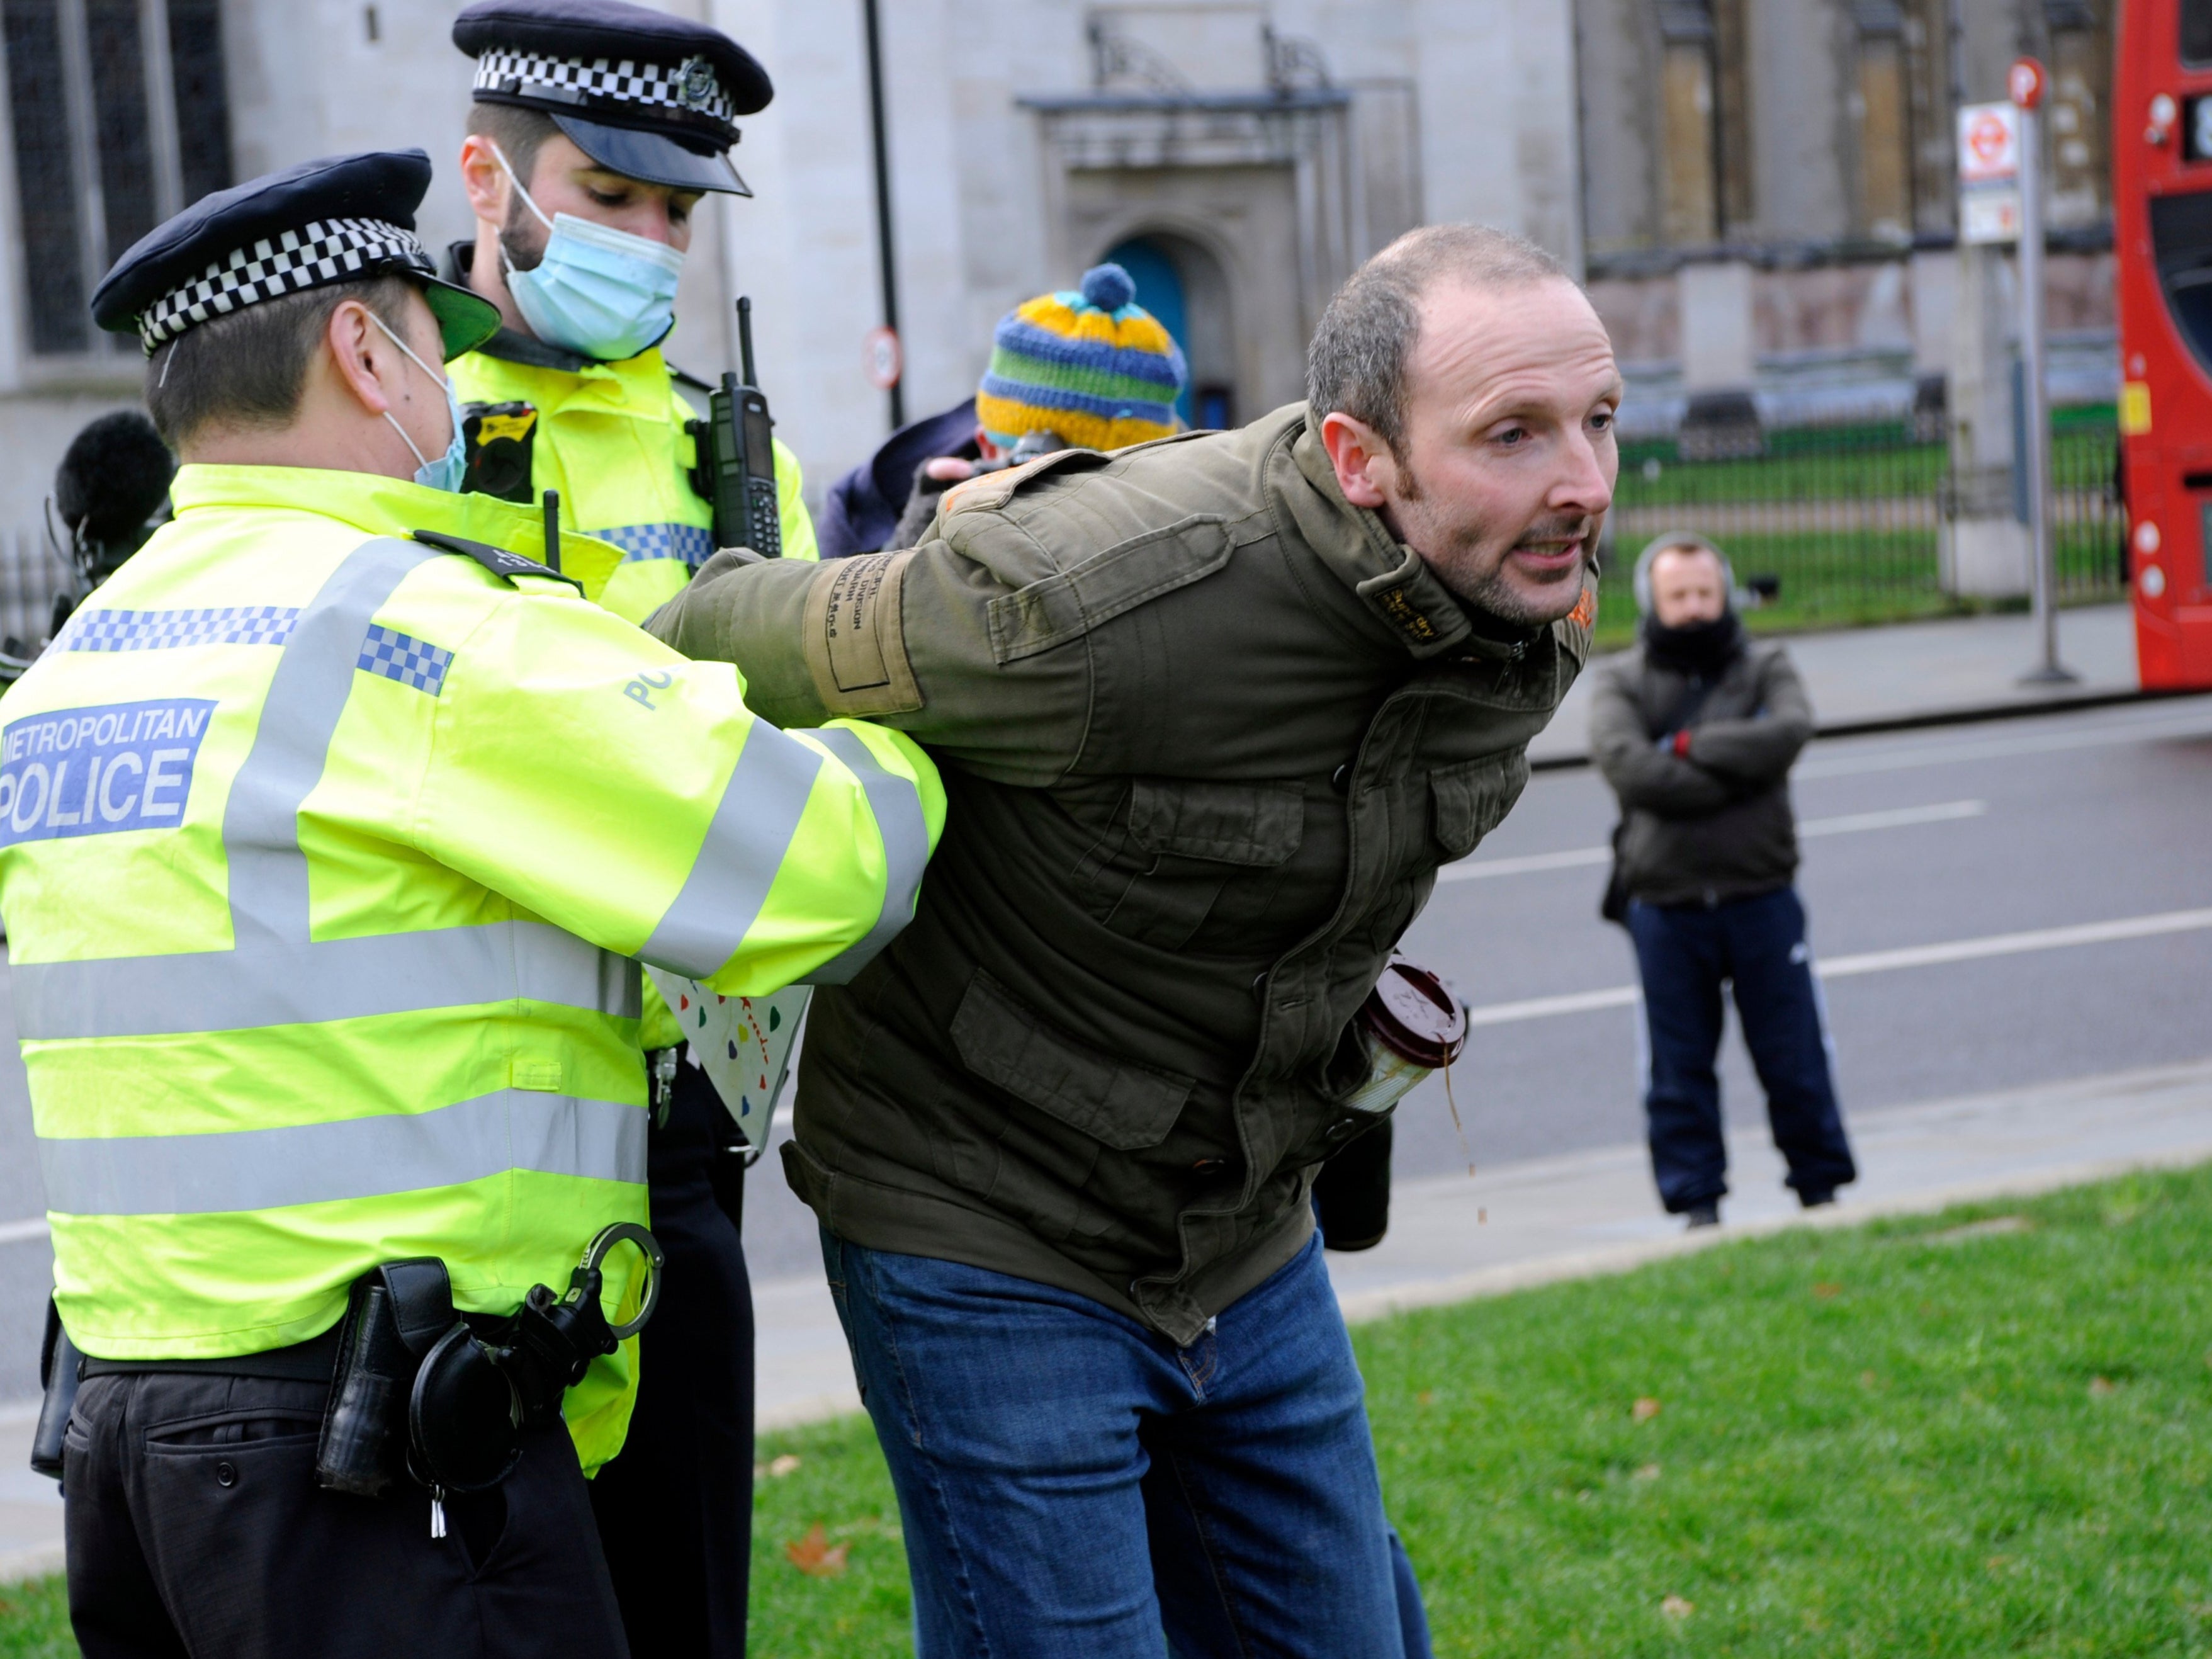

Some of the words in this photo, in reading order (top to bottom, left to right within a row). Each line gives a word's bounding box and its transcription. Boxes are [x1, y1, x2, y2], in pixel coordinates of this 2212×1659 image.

[854, 579, 870, 630] DIVISION
[3, 708, 206, 765] METROPOLITAN
[0, 748, 190, 834] POLICE
